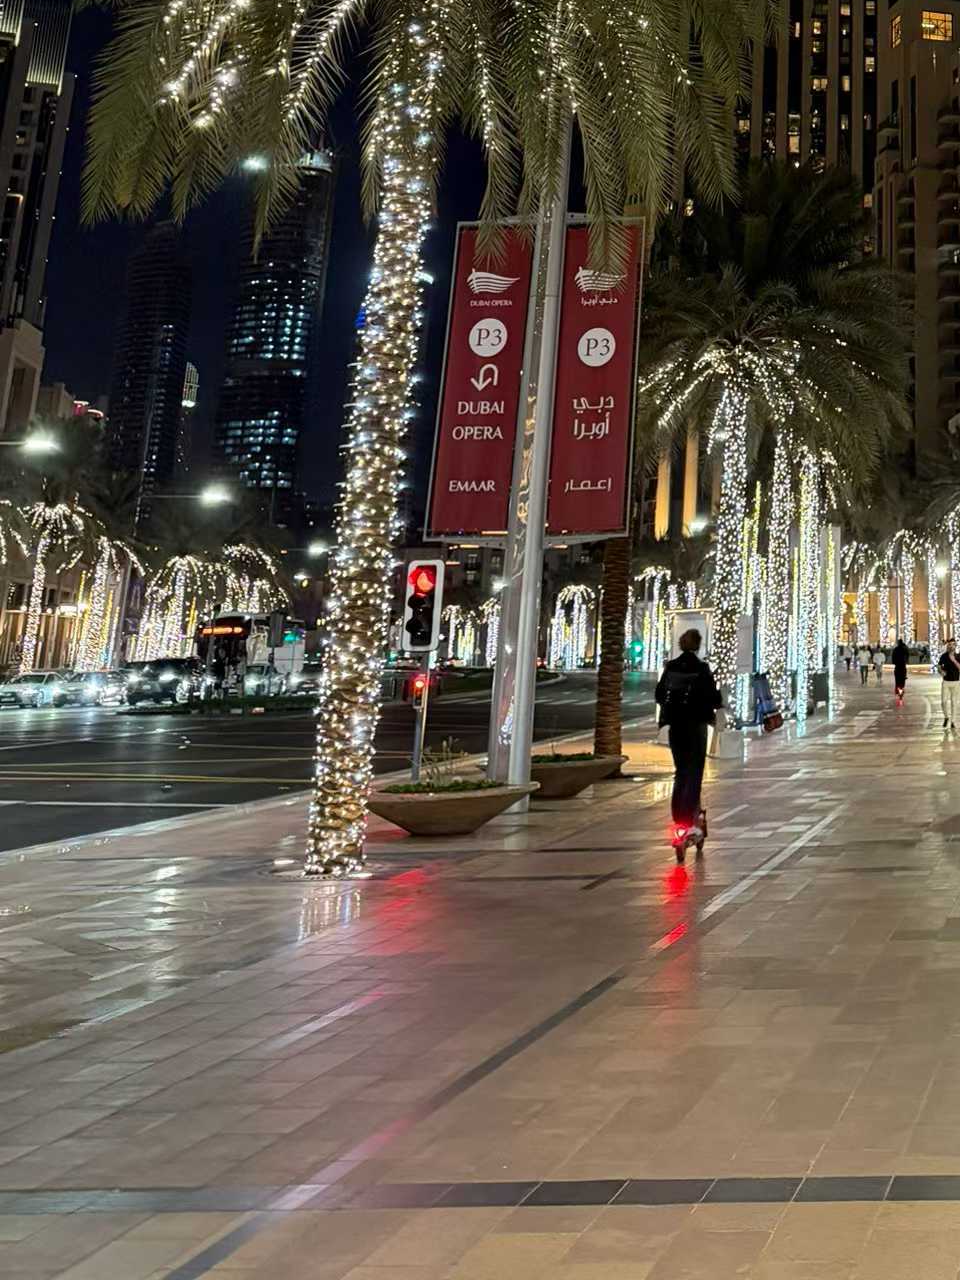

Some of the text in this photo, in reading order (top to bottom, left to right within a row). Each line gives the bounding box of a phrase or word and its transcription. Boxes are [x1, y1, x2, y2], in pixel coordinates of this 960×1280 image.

[470, 299, 490, 307] DUBAI
[475, 328, 503, 346] P3
[584, 338, 611, 357] P3
[457, 400, 505, 415] DUBAI
[572, 395, 615, 414] دبي
[452, 426, 504, 441] OPERA
[573, 412, 610, 440] أوبرا
[449, 479, 496, 492] EMAAR
